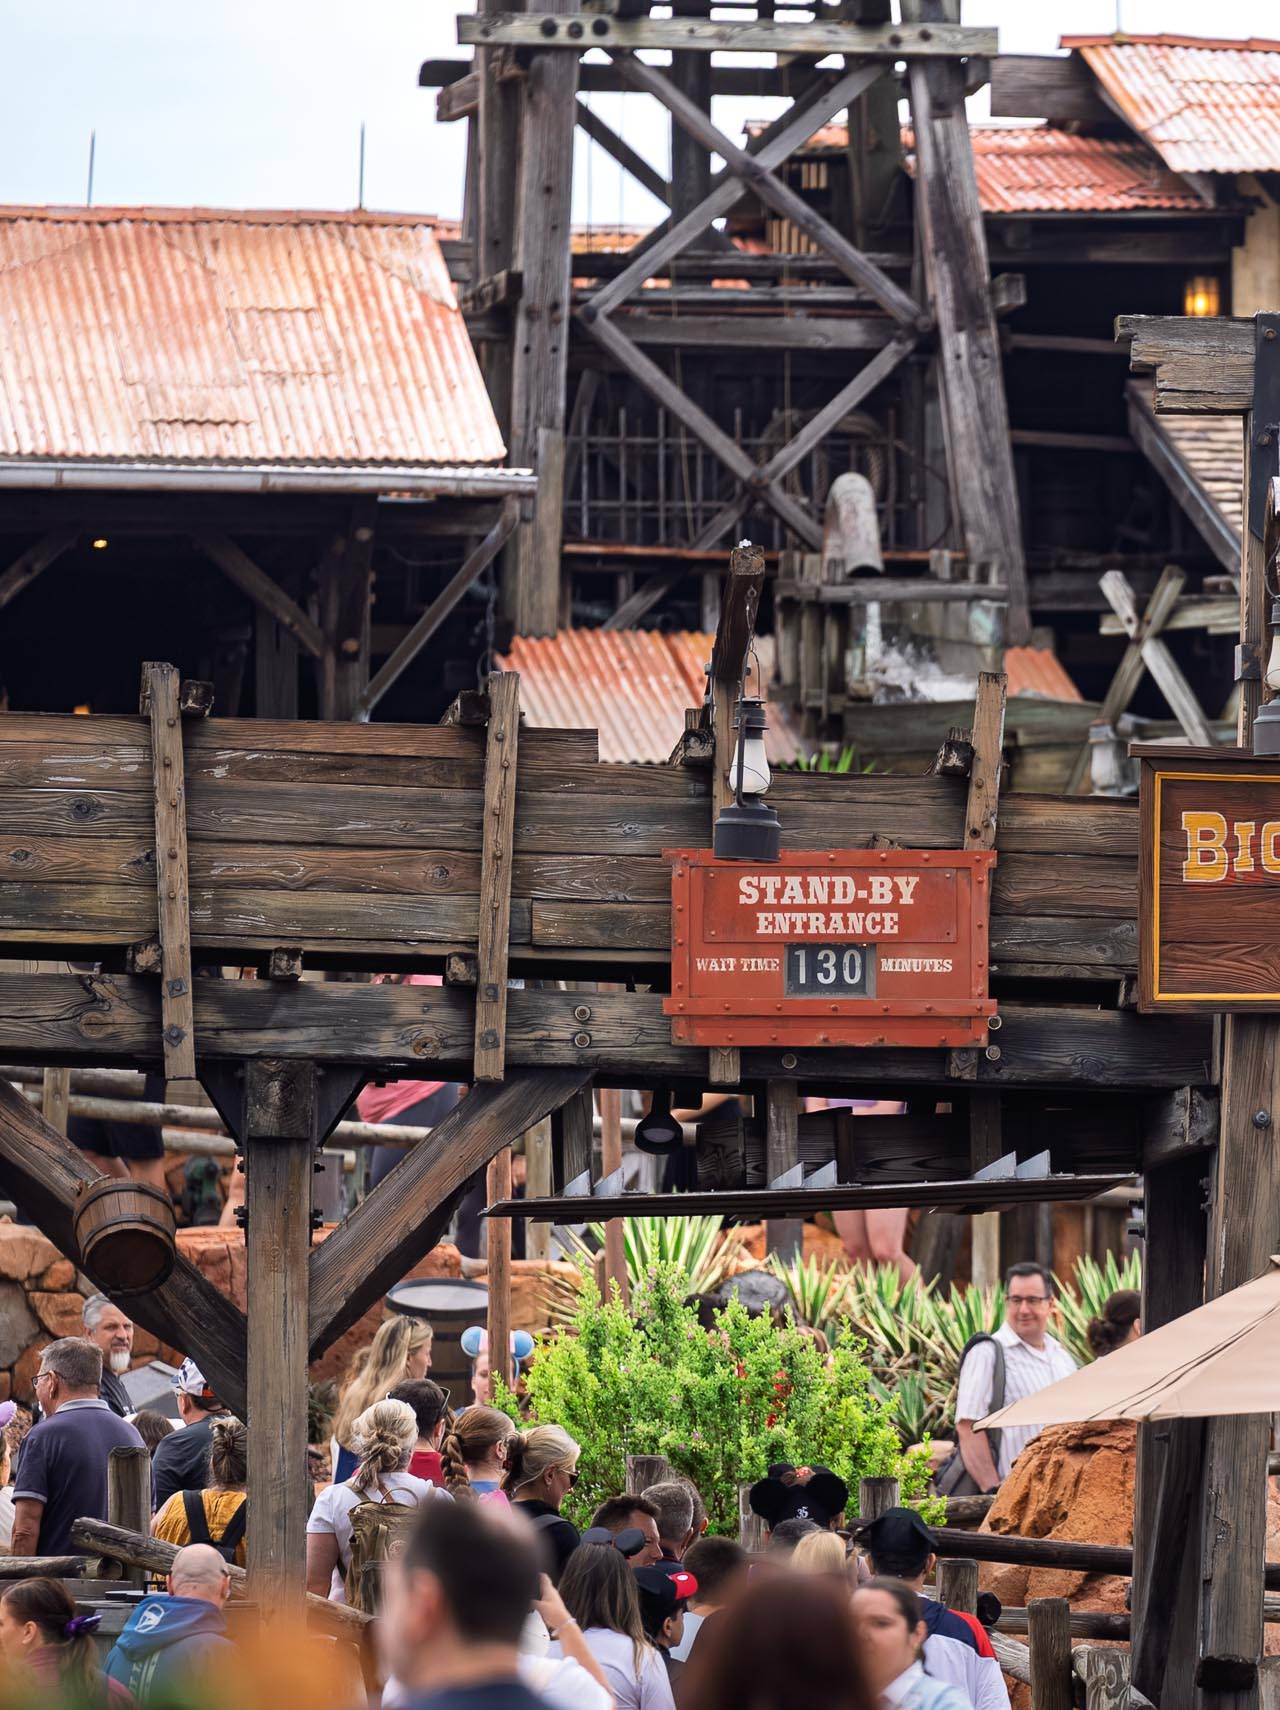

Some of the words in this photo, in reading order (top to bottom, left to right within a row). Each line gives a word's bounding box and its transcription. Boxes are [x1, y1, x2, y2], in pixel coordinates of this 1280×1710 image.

[738, 875, 920, 905] STAND-BY
[756, 912, 899, 934] ENTRANCE
[696, 957, 737, 973] WAIT
[740, 957, 780, 973] TIME
[794, 949, 863, 985] 130
[880, 957, 953, 973] MINUTES
